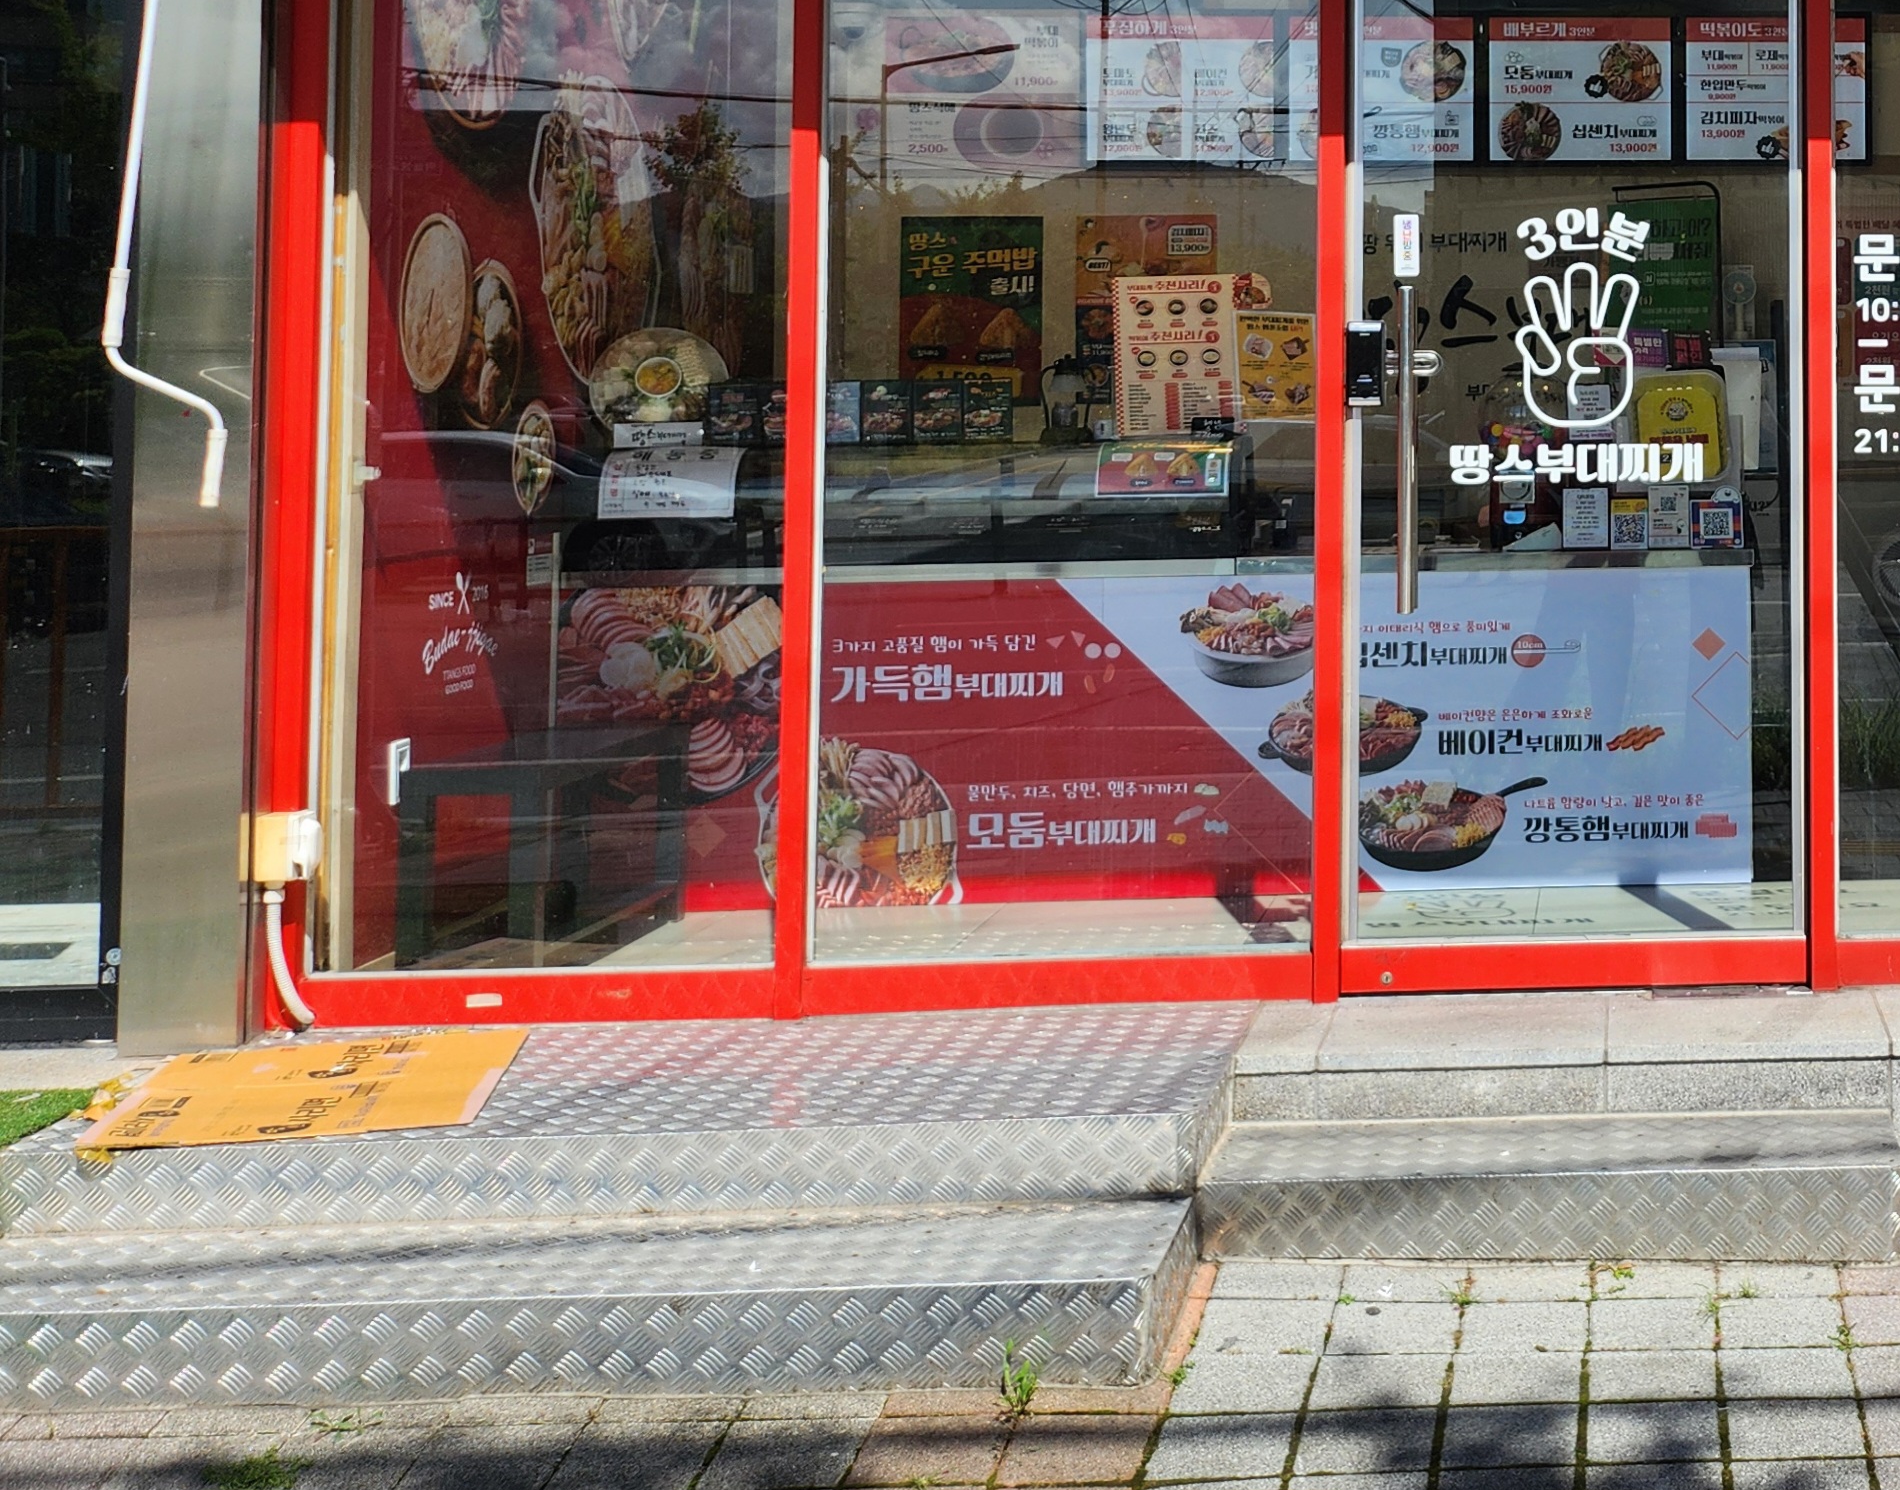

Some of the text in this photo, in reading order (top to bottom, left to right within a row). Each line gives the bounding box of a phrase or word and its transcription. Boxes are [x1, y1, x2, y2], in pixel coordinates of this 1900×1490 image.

[1502, 22, 1597, 38] 배부르게 3인분
[1700, 22, 1763, 38] 떡볶이도
[1430, 231, 1507, 253] 부대찌개
[1516, 207, 1652, 262] 3인분
[906, 246, 1038, 279] 구운 주먹밥
[1853, 233, 1900, 283] 문
[990, 275, 1035, 297] 출시!
[1853, 364, 1900, 413] 문
[1449, 442, 1705, 484] 땅스부대찌개
[428, 591, 455, 611] SINCE
[1428, 620, 1461, 634] 햄으로
[832, 634, 1036, 653] 3가지 고품질 햄이 가득 담긴
[830, 663, 1063, 703] 가득햄부대찌개
[1438, 728, 1603, 756] 베이컨부대찌개
[1062, 781, 1101, 799] 당면,
[1107, 780, 1188, 797] 햄추가까지
[966, 811, 1157, 849] 모둠부대찌개
[1523, 815, 1689, 843] 깡통햄부대찌개
